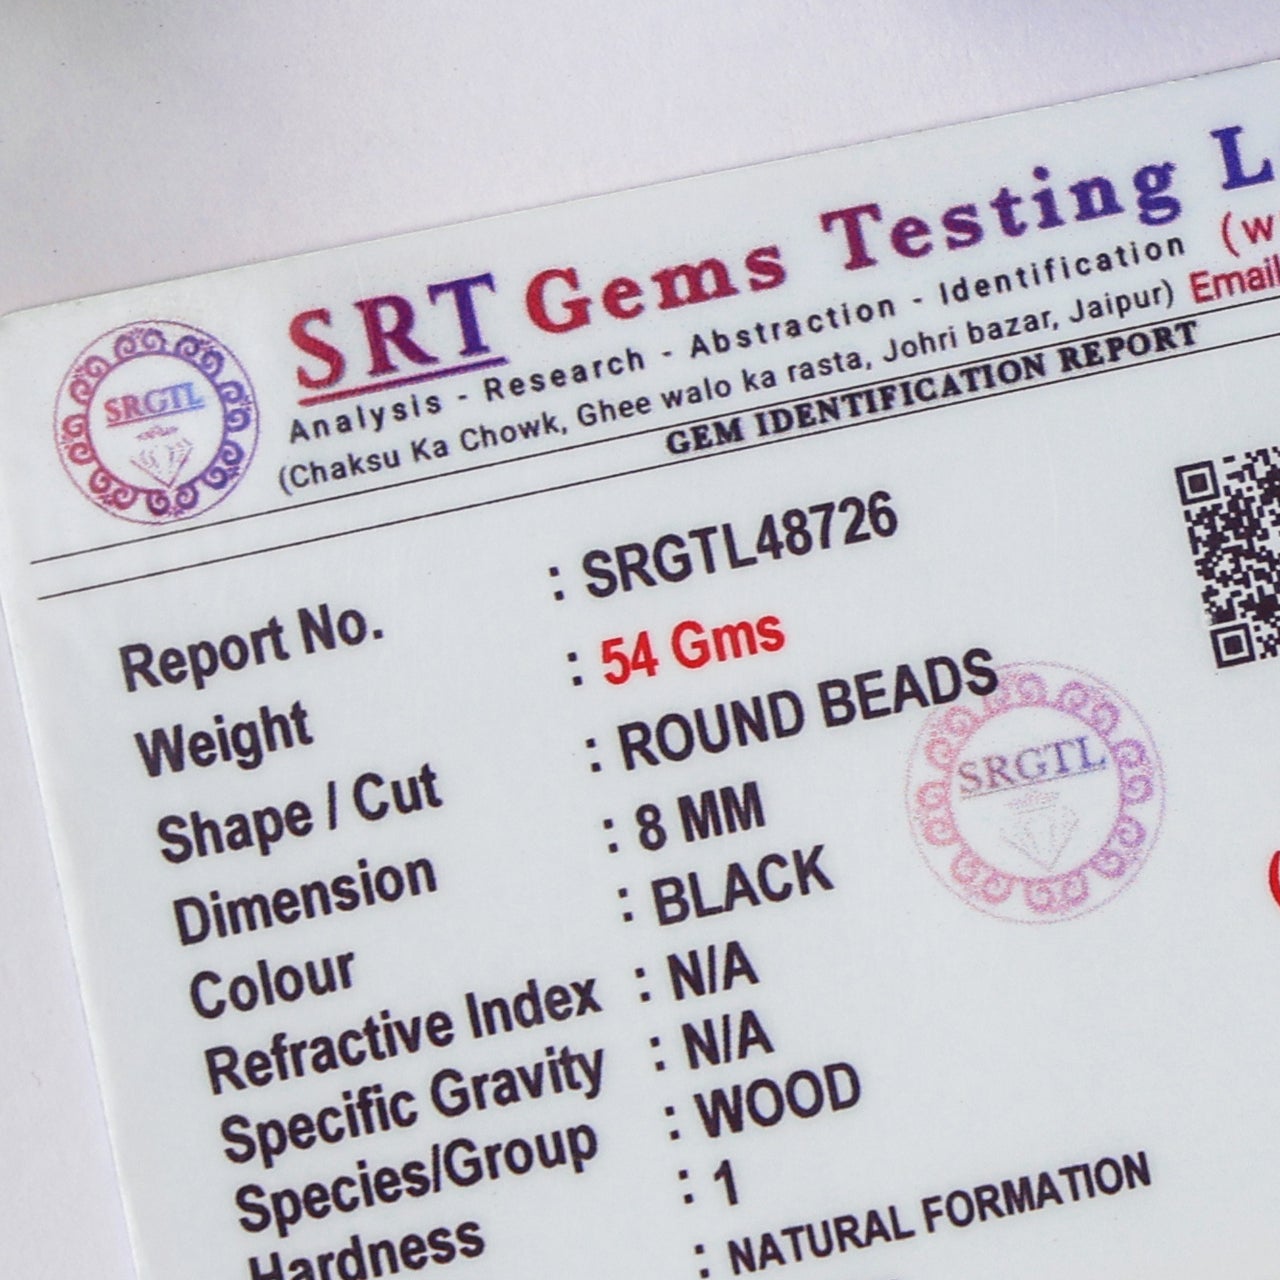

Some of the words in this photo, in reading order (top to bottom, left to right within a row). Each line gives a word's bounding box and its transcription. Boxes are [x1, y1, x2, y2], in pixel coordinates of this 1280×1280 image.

[287, 271, 496, 390] SRT
[523, 243, 788, 335] Gems
[817, 160, 1183, 271] Testing
[288, 393, 443, 444] Analysis
[482, 346, 645, 402] Research
[689, 297, 895, 359] Abstraction
[938, 236, 1185, 306] Identification
[103, 381, 205, 424] SRGTL
[277, 448, 401, 496] (Chaksu
[409, 436, 450, 463] Ka
[458, 410, 568, 452] Chowk,
[575, 395, 652, 427] Ghee
[659, 376, 732, 410] walo
[740, 367, 777, 393] ka
[786, 350, 872, 383] rasta,
[881, 325, 958, 363] Johri
[965, 309, 1059, 345] bazar,
[1069, 278, 1176, 324] Jaipur)
[666, 417, 744, 456] GEM
[755, 350, 1047, 438] IDENTIFICATION
[1059, 320, 1199, 375] REPORT
[117, 614, 290, 693] Report
[295, 602, 384, 655] No.
[580, 488, 899, 599] SRGTL48726
[132, 699, 315, 778] Weight
[599, 629, 660, 686] 54
[669, 614, 786, 670] Gms
[155, 799, 314, 865] Shape
[351, 761, 444, 822] Cut
[615, 688, 806, 771] ROUND
[815, 646, 1000, 729] BEADS
[957, 735, 1108, 794] SRGTL
[171, 856, 438, 947] Dimension
[633, 802, 668, 852] 8
[675, 779, 766, 843] MM
[188, 950, 355, 1020] Colour
[649, 842, 835, 927] BLACK
[202, 1008, 454, 1096] Refractive
[463, 977, 603, 1039] Index
[665, 939, 760, 1002] N/A
[219, 1082, 419, 1170] Specific
[429, 1044, 604, 1119] Gravity
[679, 1008, 775, 1070] N/A
[233, 1122, 599, 1239] Species/Group
[691, 1060, 862, 1139] WOOD
[712, 1157, 739, 1207] 1
[726, 1204, 917, 1276] NATURAL
[919, 1149, 1152, 1234] FORMATION
